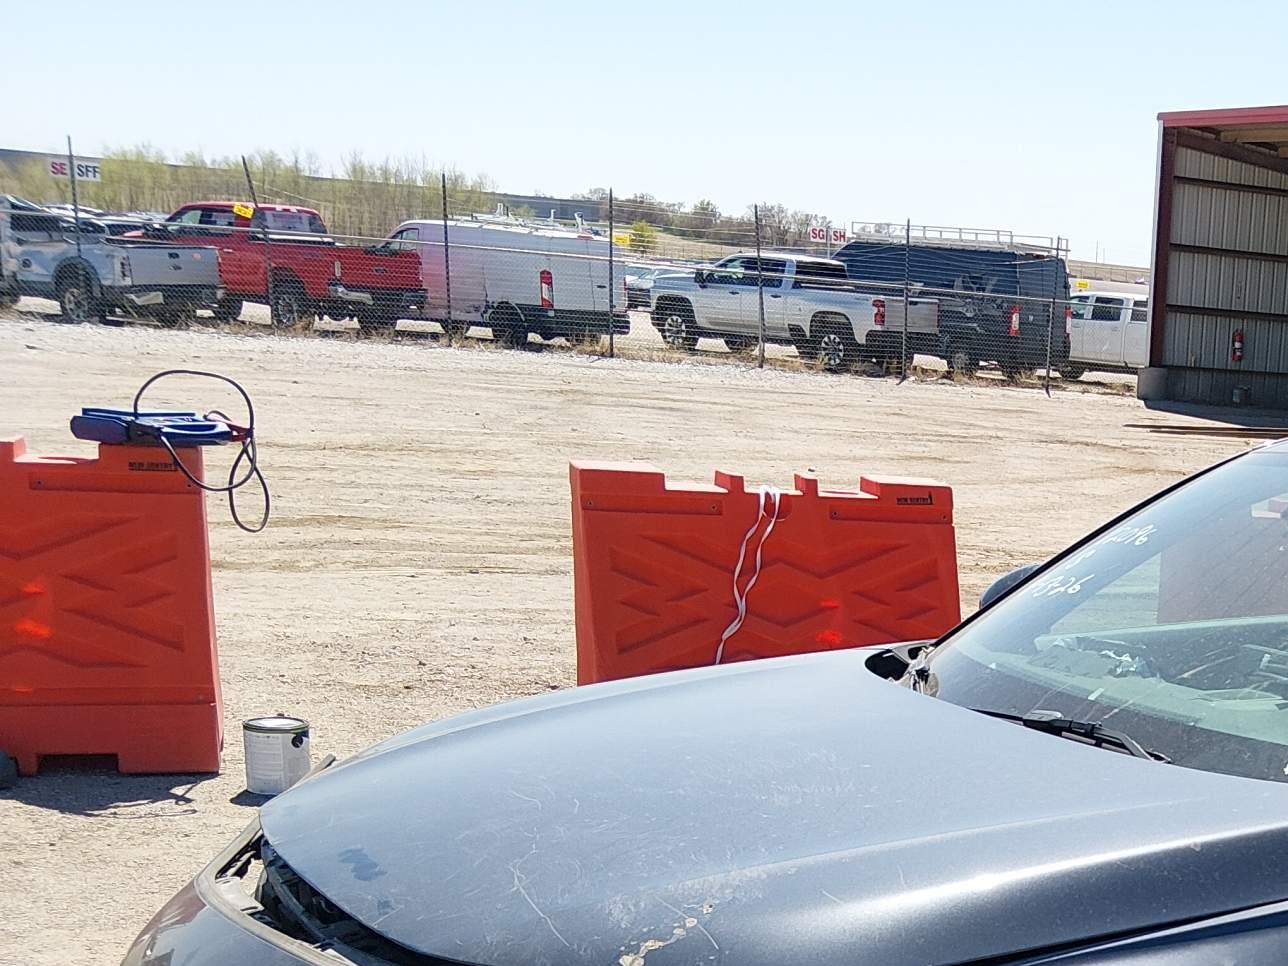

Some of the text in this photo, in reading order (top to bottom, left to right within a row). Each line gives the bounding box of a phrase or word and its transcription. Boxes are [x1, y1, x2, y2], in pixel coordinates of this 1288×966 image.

[50, 162, 67, 176] SE
[76, 163, 100, 178] SFF
[811, 228, 825, 240] SG
[832, 230, 846, 242] SH
